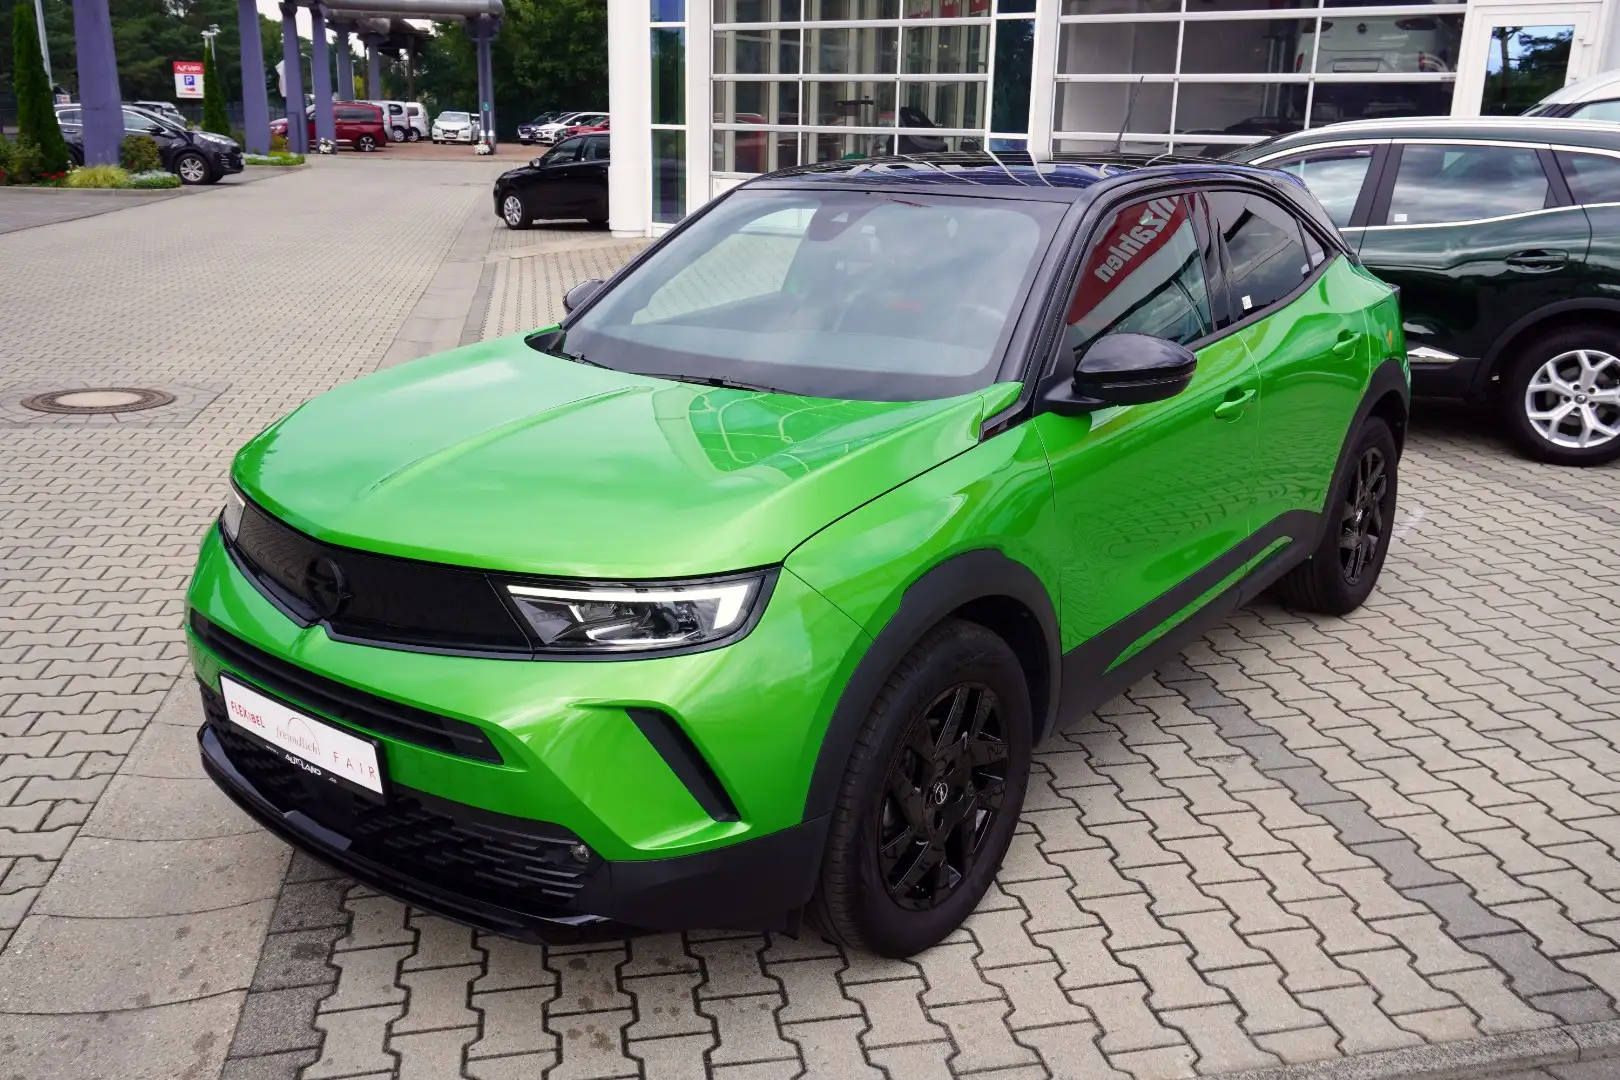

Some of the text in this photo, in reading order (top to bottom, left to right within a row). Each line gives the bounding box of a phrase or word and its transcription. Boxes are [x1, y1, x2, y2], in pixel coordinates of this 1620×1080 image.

[230, 700, 266, 729] FLEXIBEL
[333, 751, 377, 780] FAIR
[285, 753, 322, 776] AUTOLAND
